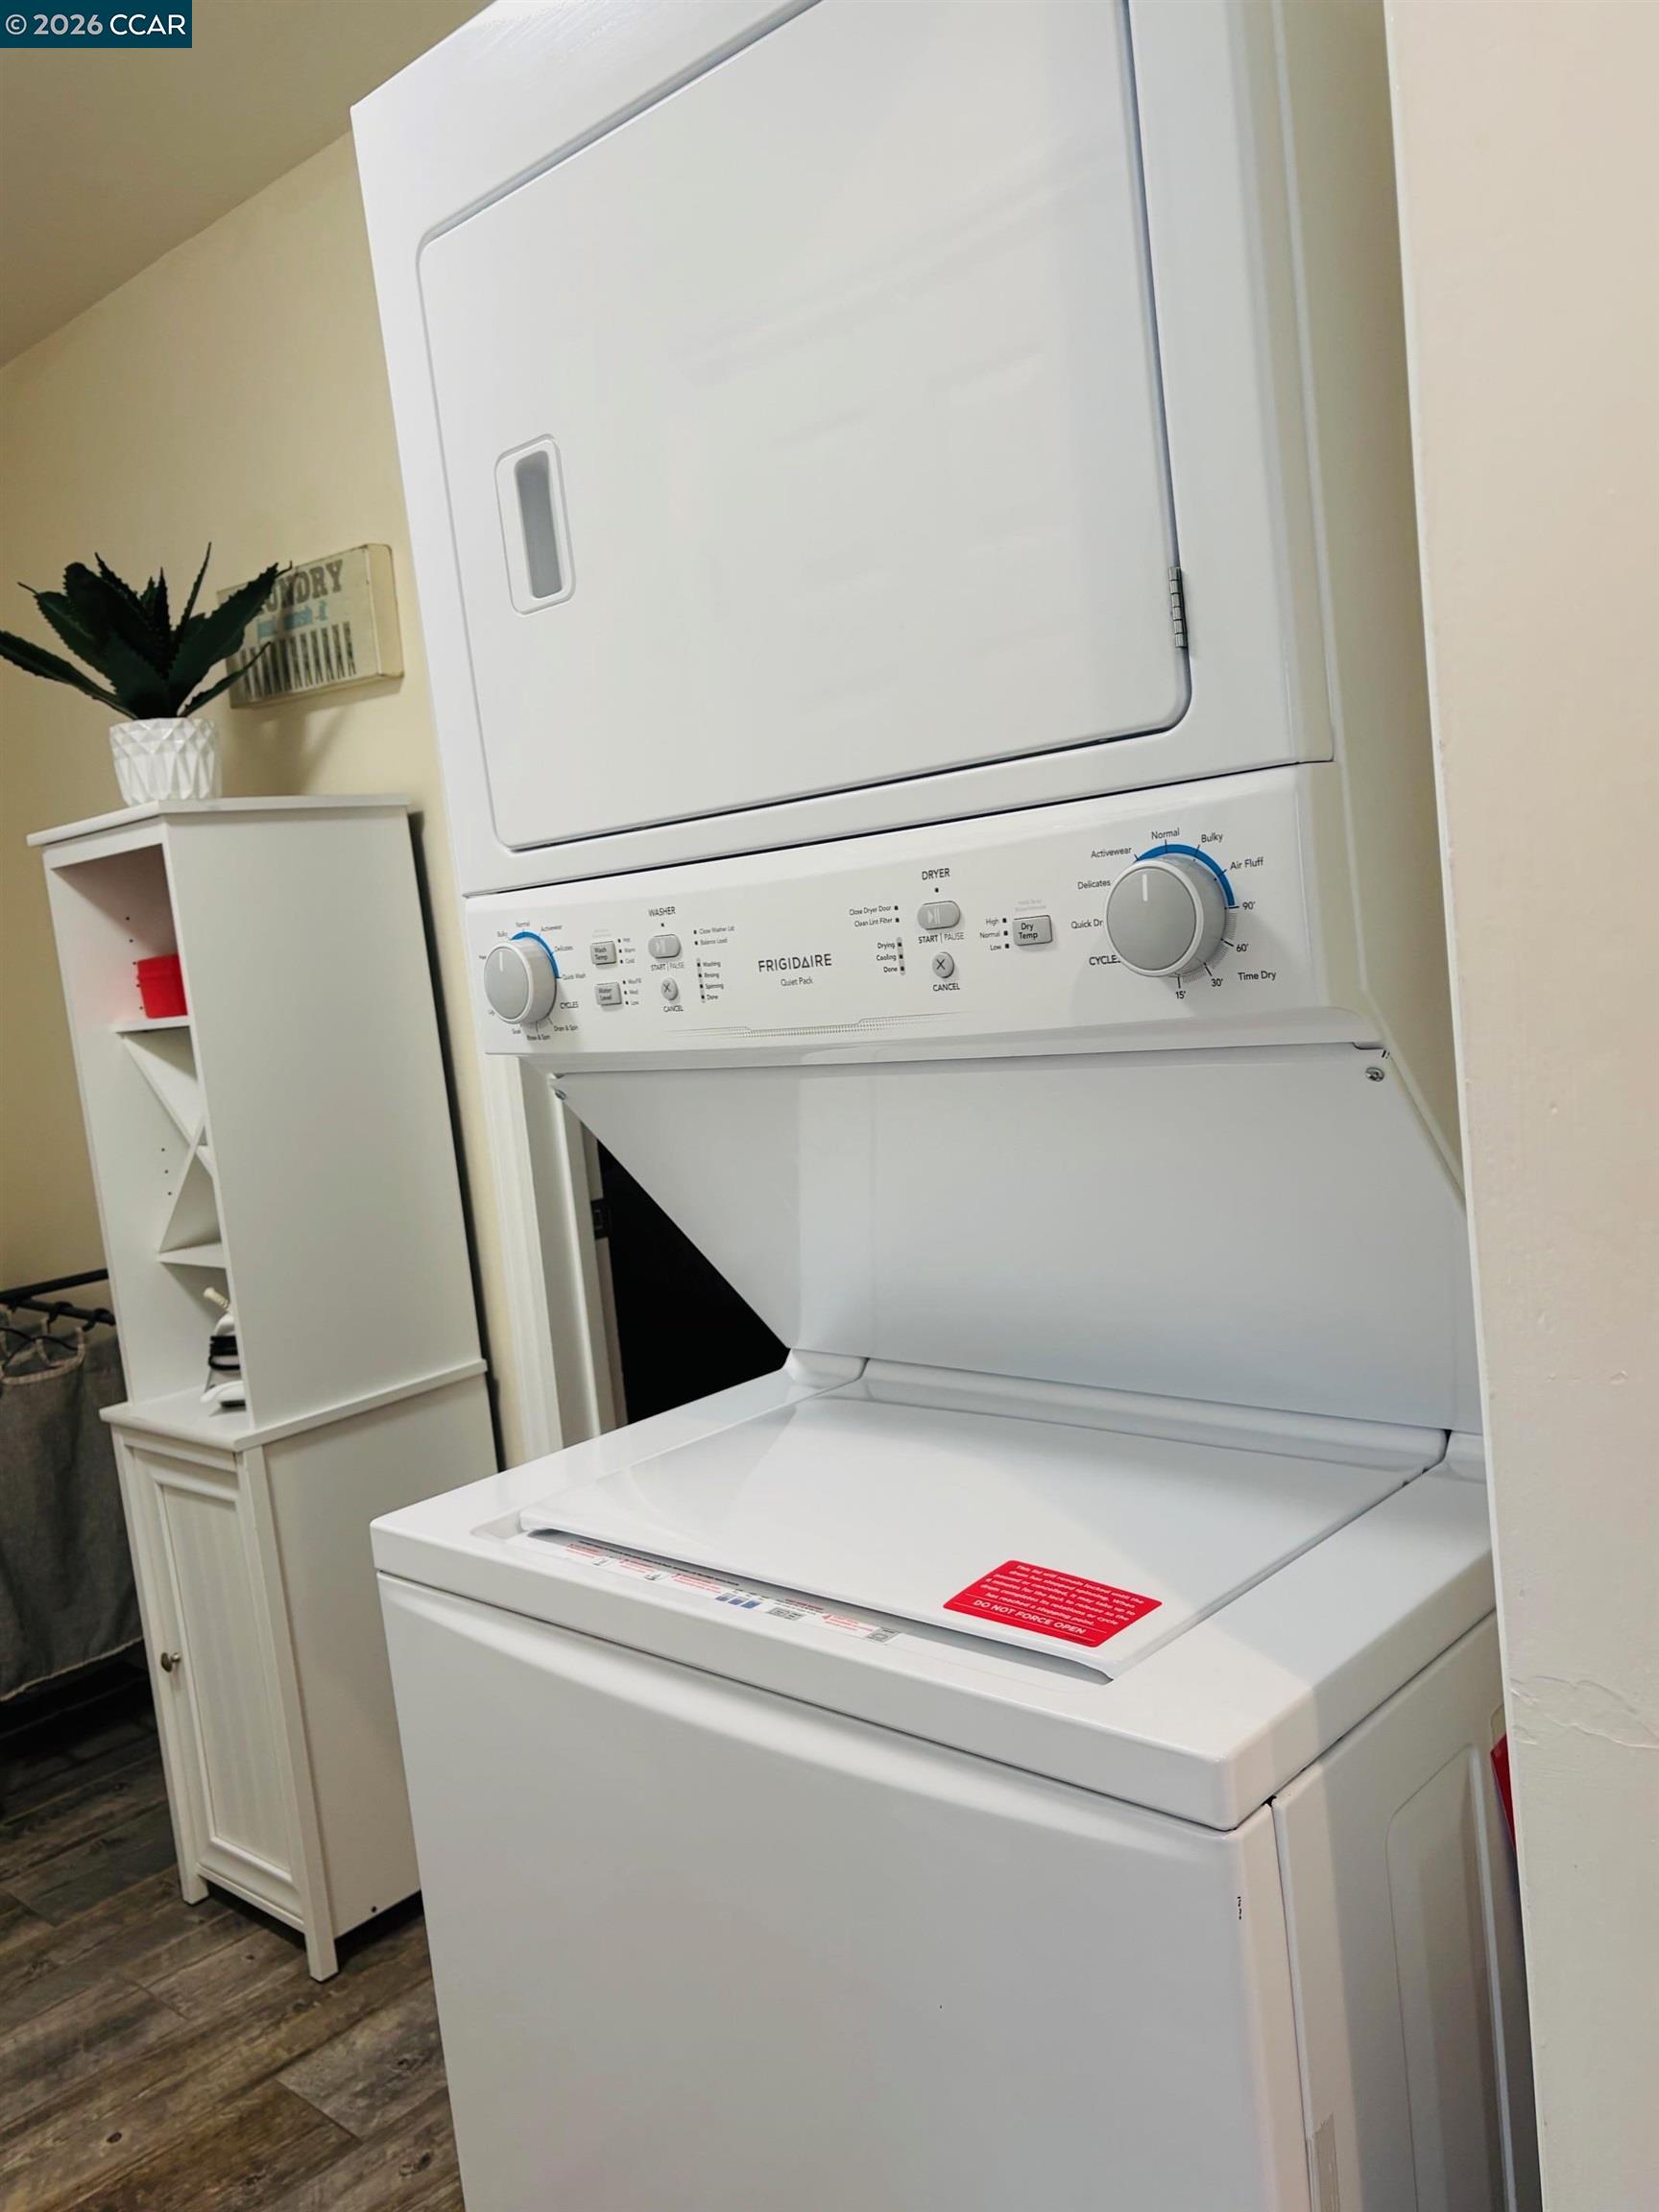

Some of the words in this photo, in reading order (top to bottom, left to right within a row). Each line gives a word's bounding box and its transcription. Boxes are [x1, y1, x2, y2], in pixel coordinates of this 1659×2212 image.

[1151, 828, 1180, 840] Normal
[1201, 832, 1224, 844] Bulky
[1091, 846, 1132, 859] Activewear
[1230, 860, 1242, 871] Air
[1244, 856, 1264, 869] Fluff
[922, 867, 950, 880] DRYER
[1077, 879, 1111, 890] Delicates
[648, 906, 676, 917] WASHER
[985, 917, 998, 926] High
[1022, 923, 1034, 931] Dry
[1070, 919, 1092, 930] Quick
[1094, 919, 1103, 927] Dr
[918, 934, 938, 944] START
[944, 931, 965, 941] PAUSE
[979, 930, 1000, 939] Normal
[757, 953, 832, 973] FRIGIDAIRE
[1089, 954, 1121, 966] CYCLE
[780, 977, 798, 987] Quiet
[799, 975, 813, 985] Pack
[1238, 972, 1260, 981] Time
[1262, 970, 1277, 981] Dry
[932, 982, 960, 992] CANCEL
[663, 1004, 684, 1013] CANCEL
[973, 1599, 991, 1608] DO
[990, 1604, 1016, 1615] NOT
[1015, 1611, 1053, 1625] FORCE
[1053, 1622, 1087, 1634] OPEN
